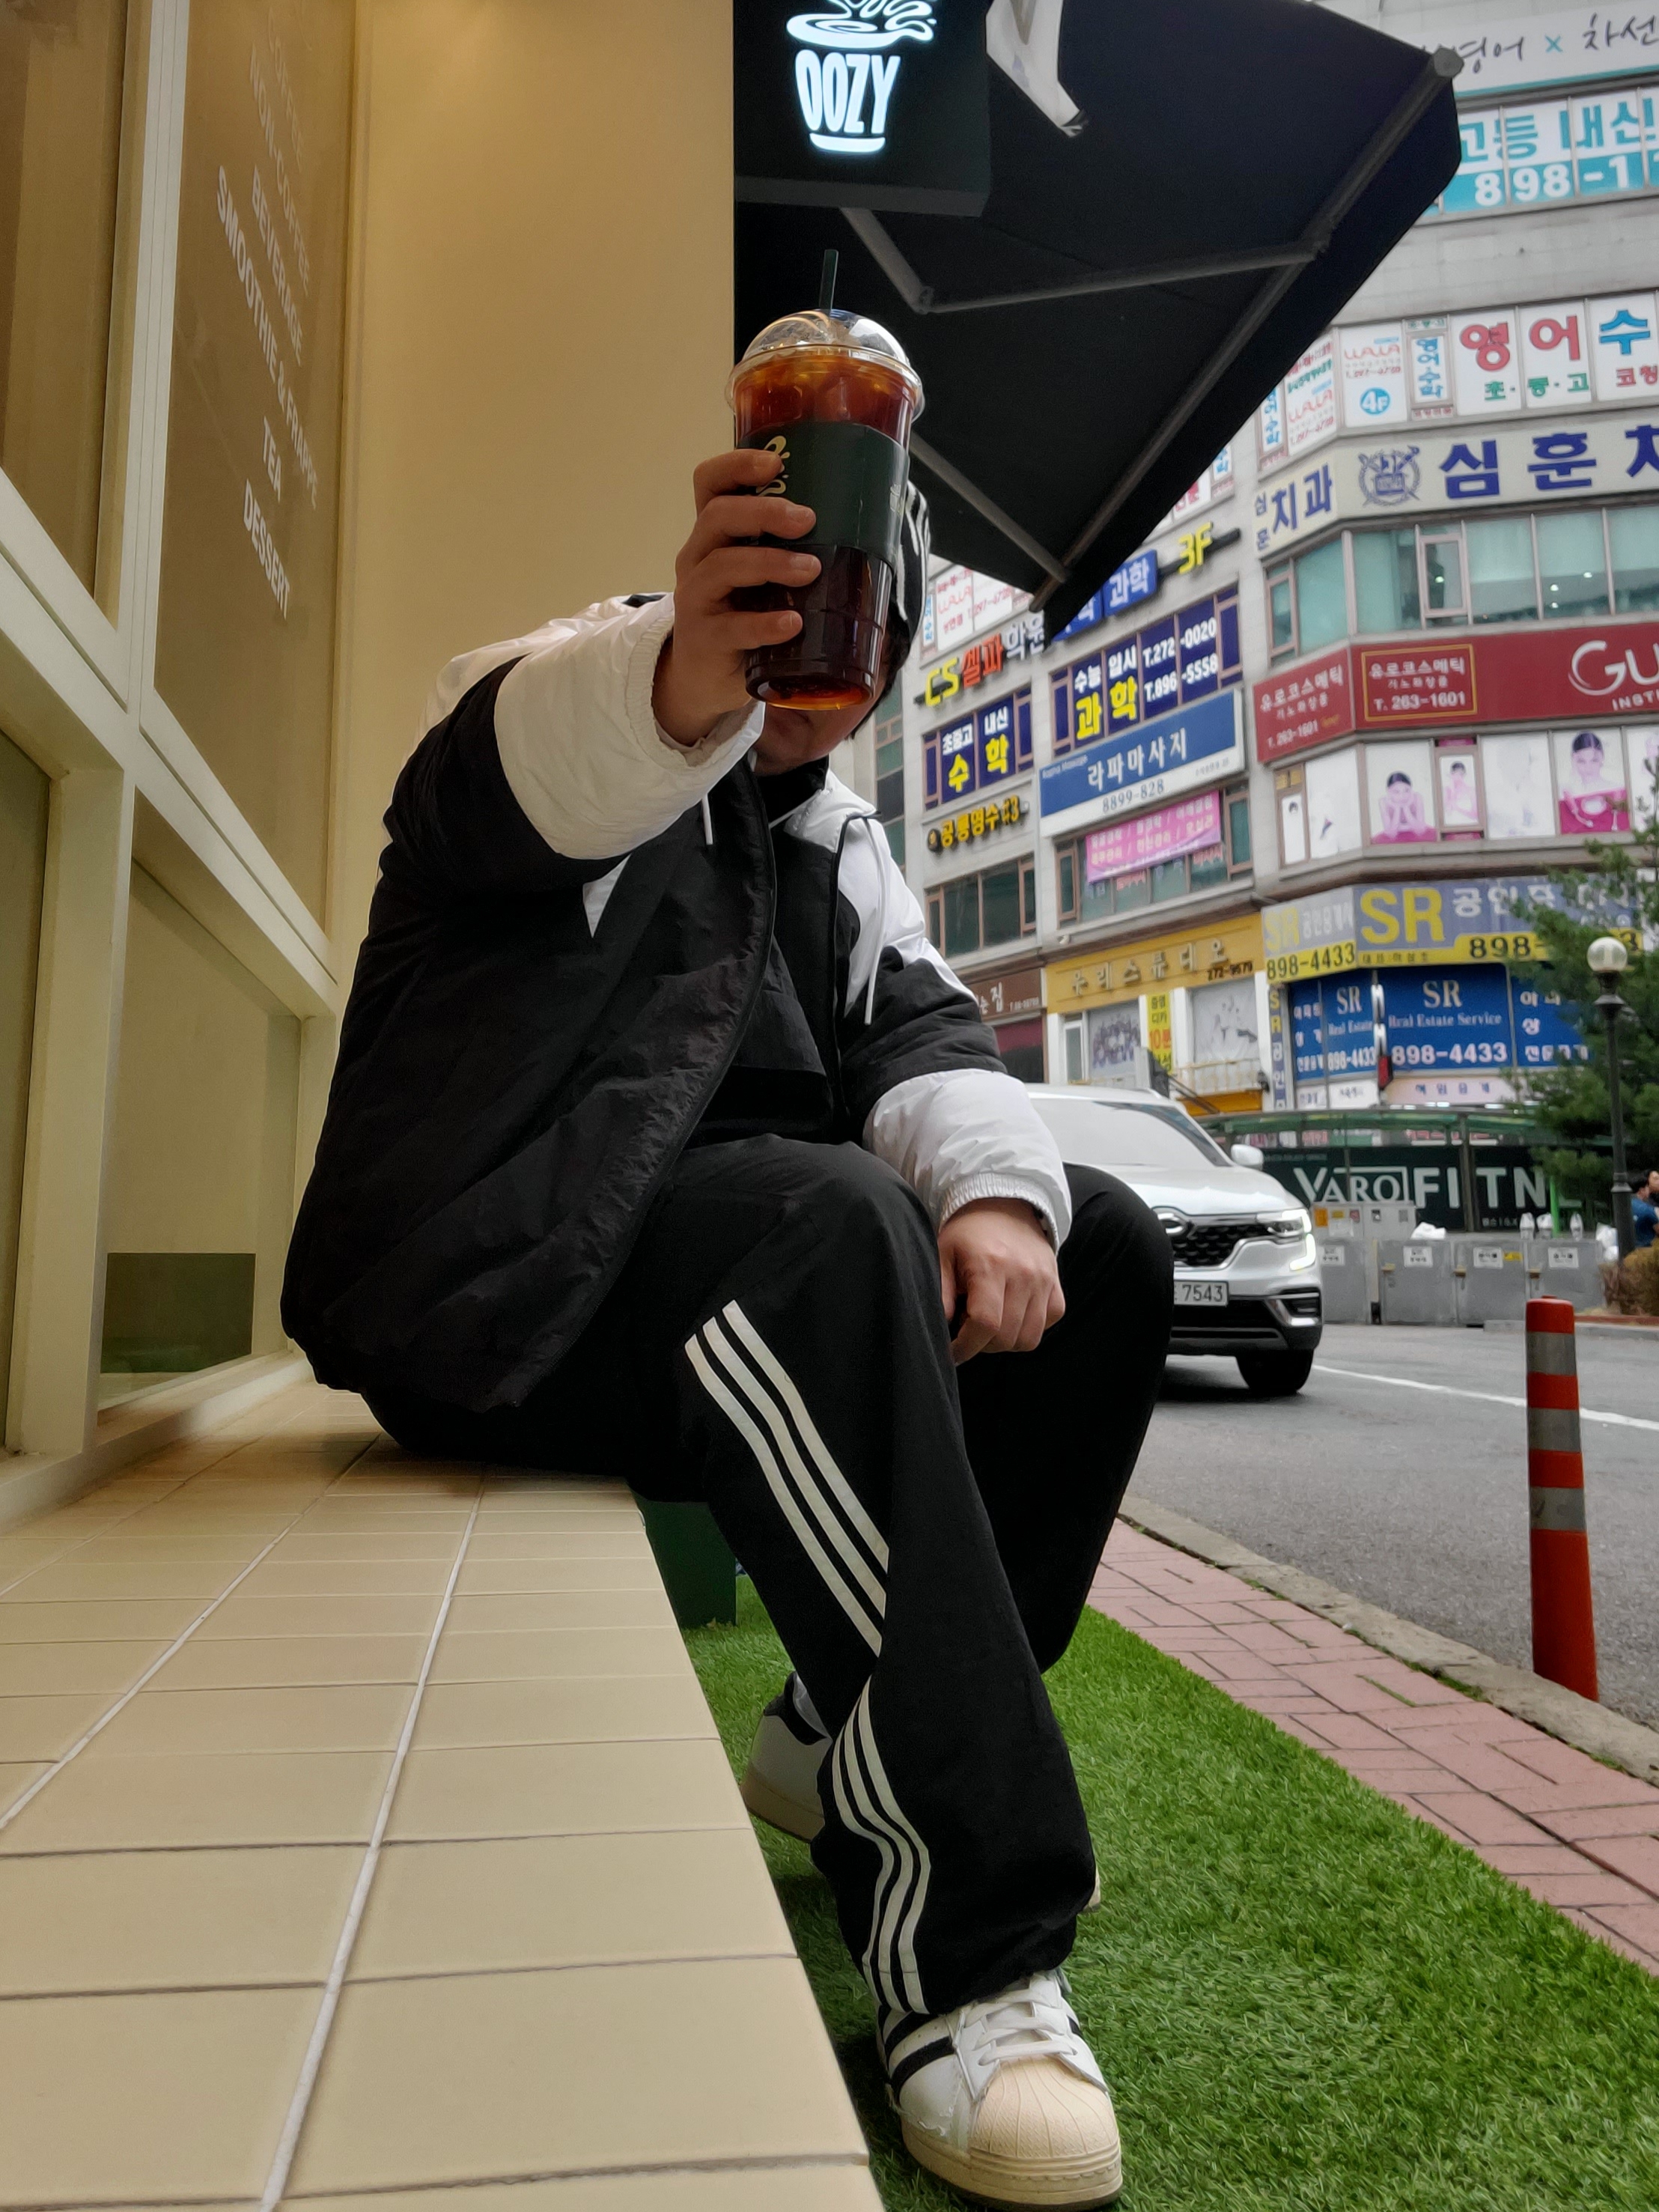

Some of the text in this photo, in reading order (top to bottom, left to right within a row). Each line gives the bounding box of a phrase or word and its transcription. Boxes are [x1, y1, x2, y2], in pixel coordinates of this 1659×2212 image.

[252, 163, 303, 368] BEVERAGE
[216, 165, 278, 384] SMOOTHIE
[286, 386, 317, 511] FRAPPE
[1459, 315, 1581, 372] 영어
[263, 415, 281, 503] TEA
[1271, 464, 1333, 534] 치과
[243, 478, 290, 621] DESSERT
[1178, 522, 1214, 574] 3F
[1109, 557, 1151, 608] 과학
[925, 657, 961, 707] CS
[1108, 644, 1138, 679] 입시
[984, 705, 1008, 736] 내신
[1088, 726, 1188, 791] 라파마사지
[1359, 887, 1446, 944] SR
[1266, 942, 1355, 981] 898-4433
[1336, 985, 1363, 1015] SR
[1422, 979, 1463, 1009] SR
[1457, 1011, 1503, 1027] Service
[1391, 1042, 1509, 1066] 898-4433
[1182, 1283, 1224, 1303] 7543
